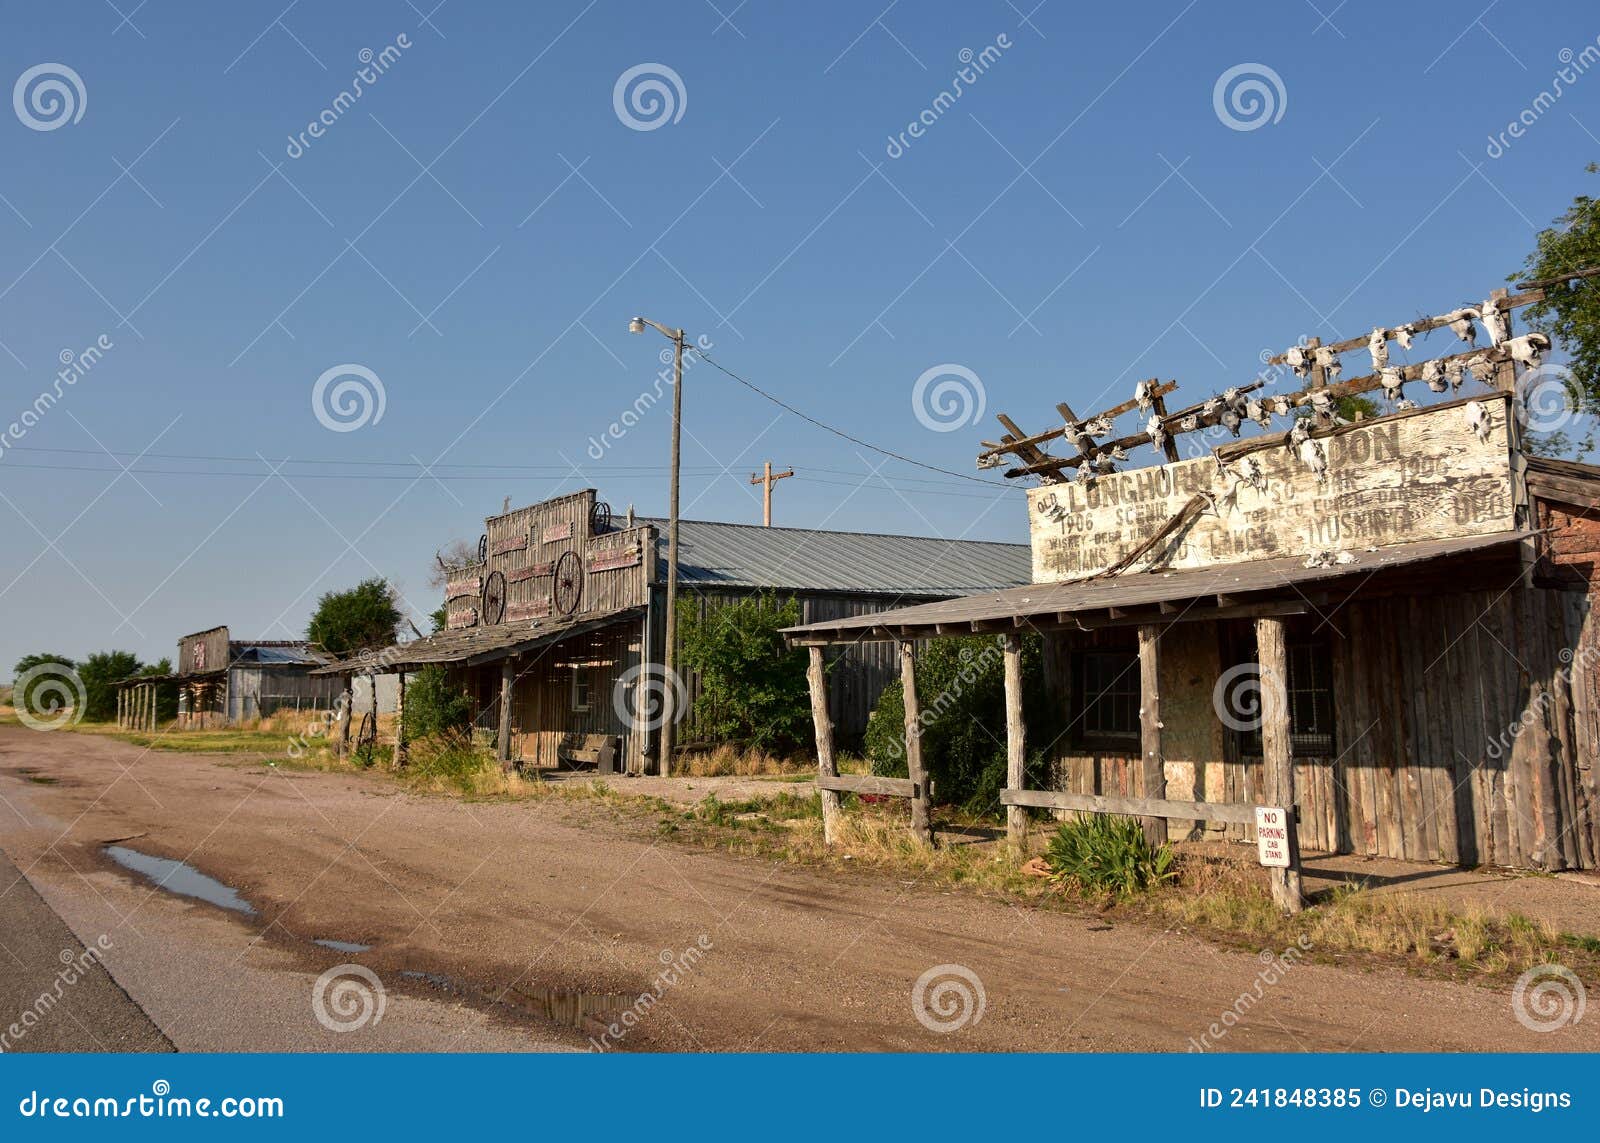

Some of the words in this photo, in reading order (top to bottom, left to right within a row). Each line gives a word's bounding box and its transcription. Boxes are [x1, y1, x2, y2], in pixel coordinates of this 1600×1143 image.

[1037, 491, 1058, 515] OLD
[1068, 459, 1214, 514] LONGHORN
[1060, 512, 1094, 535] 1906
[1116, 502, 1169, 527] SCENIC
[1264, 812, 1278, 824] NO
[1258, 827, 1285, 840] PARKING
[1267, 840, 1279, 849] CAB
[1265, 850, 1283, 860] STAND
